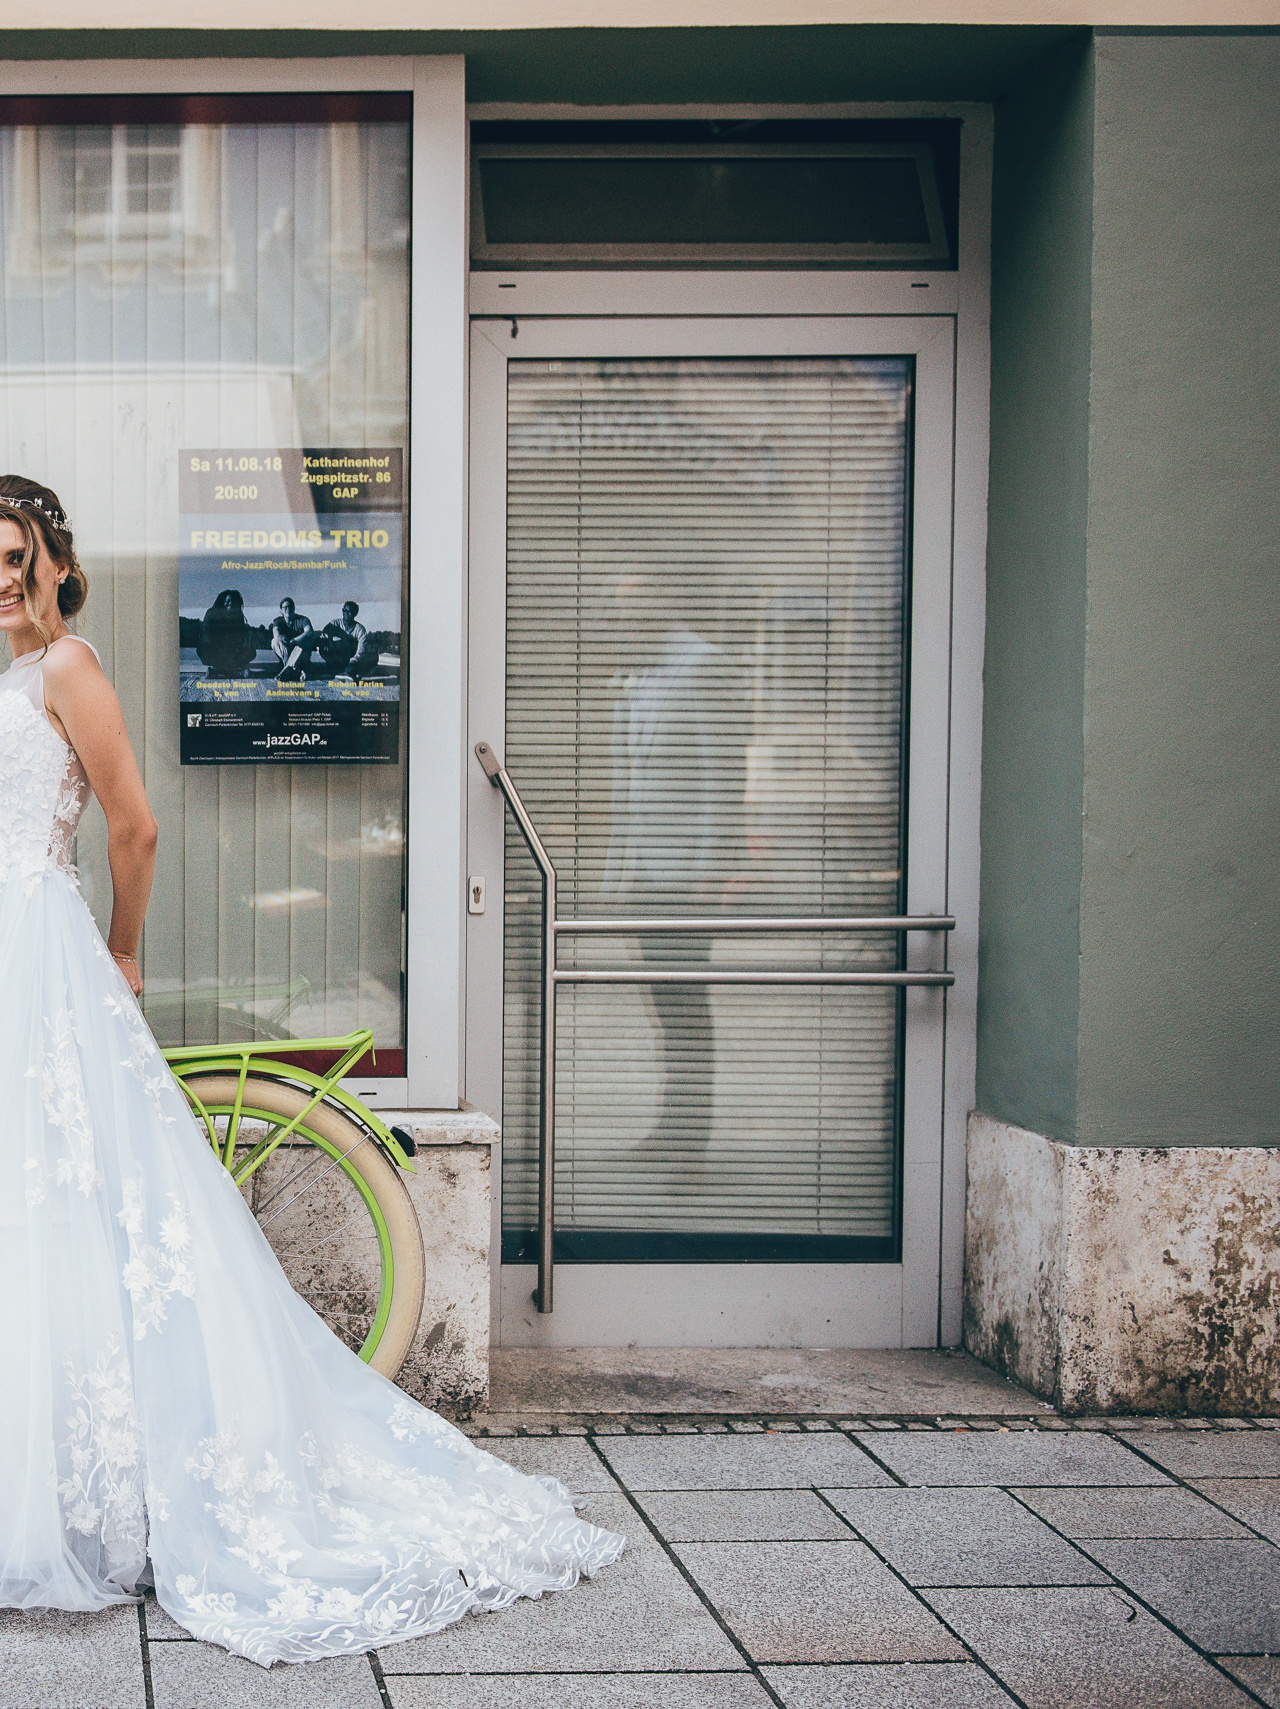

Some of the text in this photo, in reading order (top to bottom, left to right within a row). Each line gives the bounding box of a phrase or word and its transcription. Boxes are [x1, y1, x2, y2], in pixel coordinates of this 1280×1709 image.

[190, 457, 283, 472] Sa 11.08.18
[303, 456, 390, 468] Katharinenhof
[300, 472, 391, 485] Zugspitzstr. 86
[214, 485, 258, 500] 20:00
[332, 487, 359, 499] GAP
[191, 530, 389, 549] FREEDOMS TRIO
[221, 560, 347, 570] Afro-Jazz/Rock/Samba/Funk
[252, 733, 327, 748] www.jazzGAP.de
